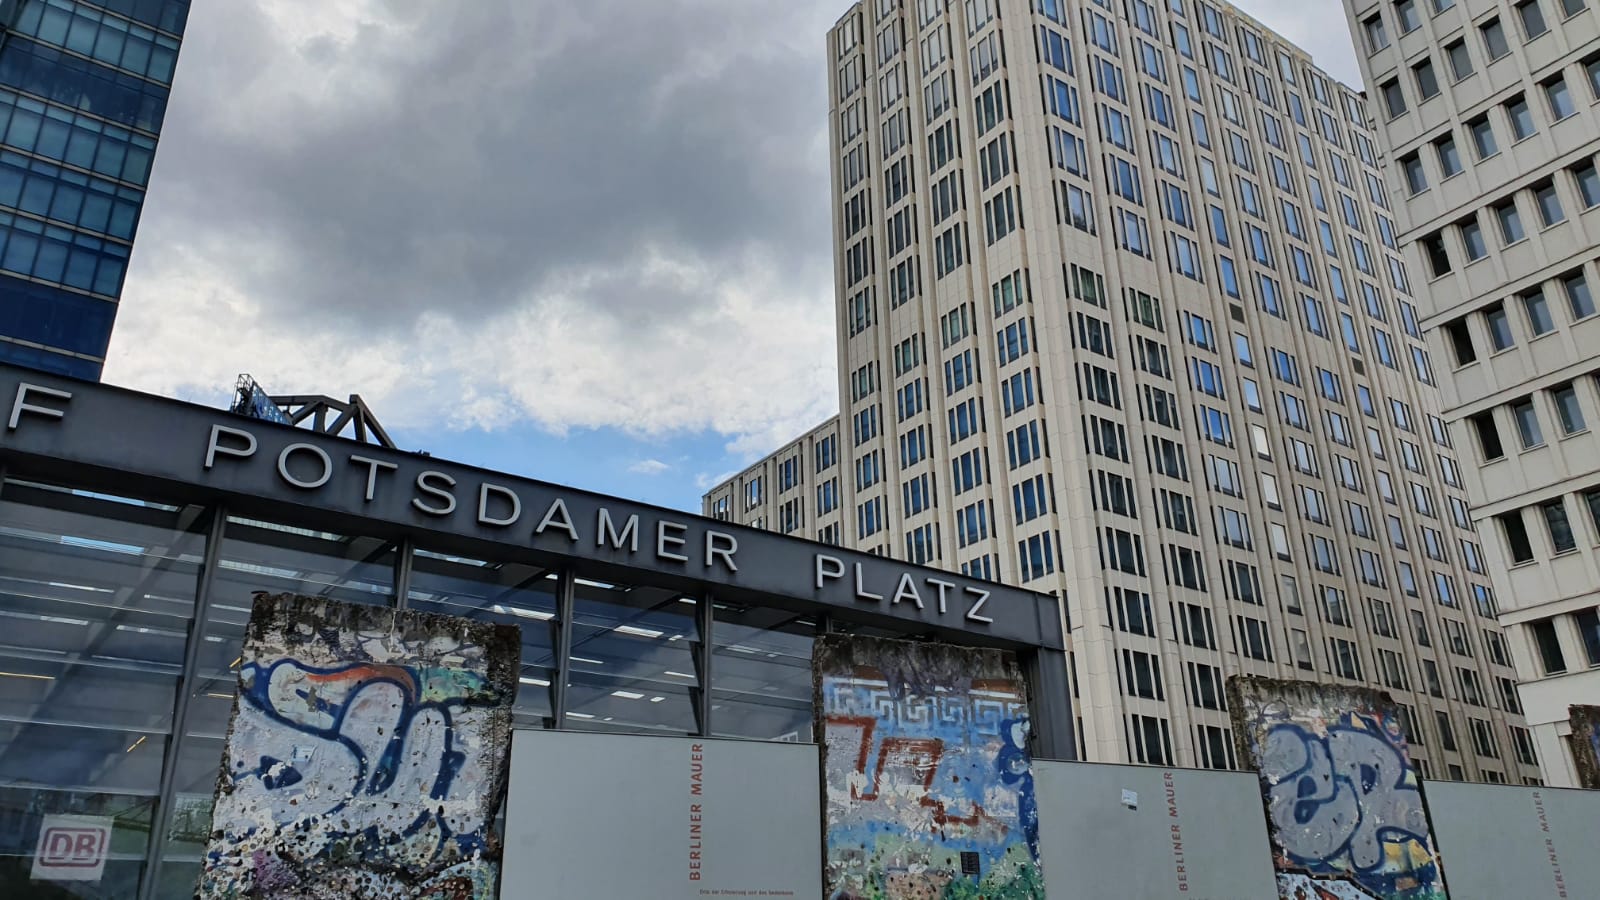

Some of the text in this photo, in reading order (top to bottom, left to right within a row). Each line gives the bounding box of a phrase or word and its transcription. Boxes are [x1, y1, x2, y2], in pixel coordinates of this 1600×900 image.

[205, 424, 739, 572] POTSDAMER
[815, 553, 995, 624] PLATZ
[49, 833, 98, 860] DB
[689, 744, 703, 880] BERLINER MAUER
[1163, 772, 1188, 891] BERLINER MAUER
[1533, 791, 1567, 898] BERLINER MAUER
